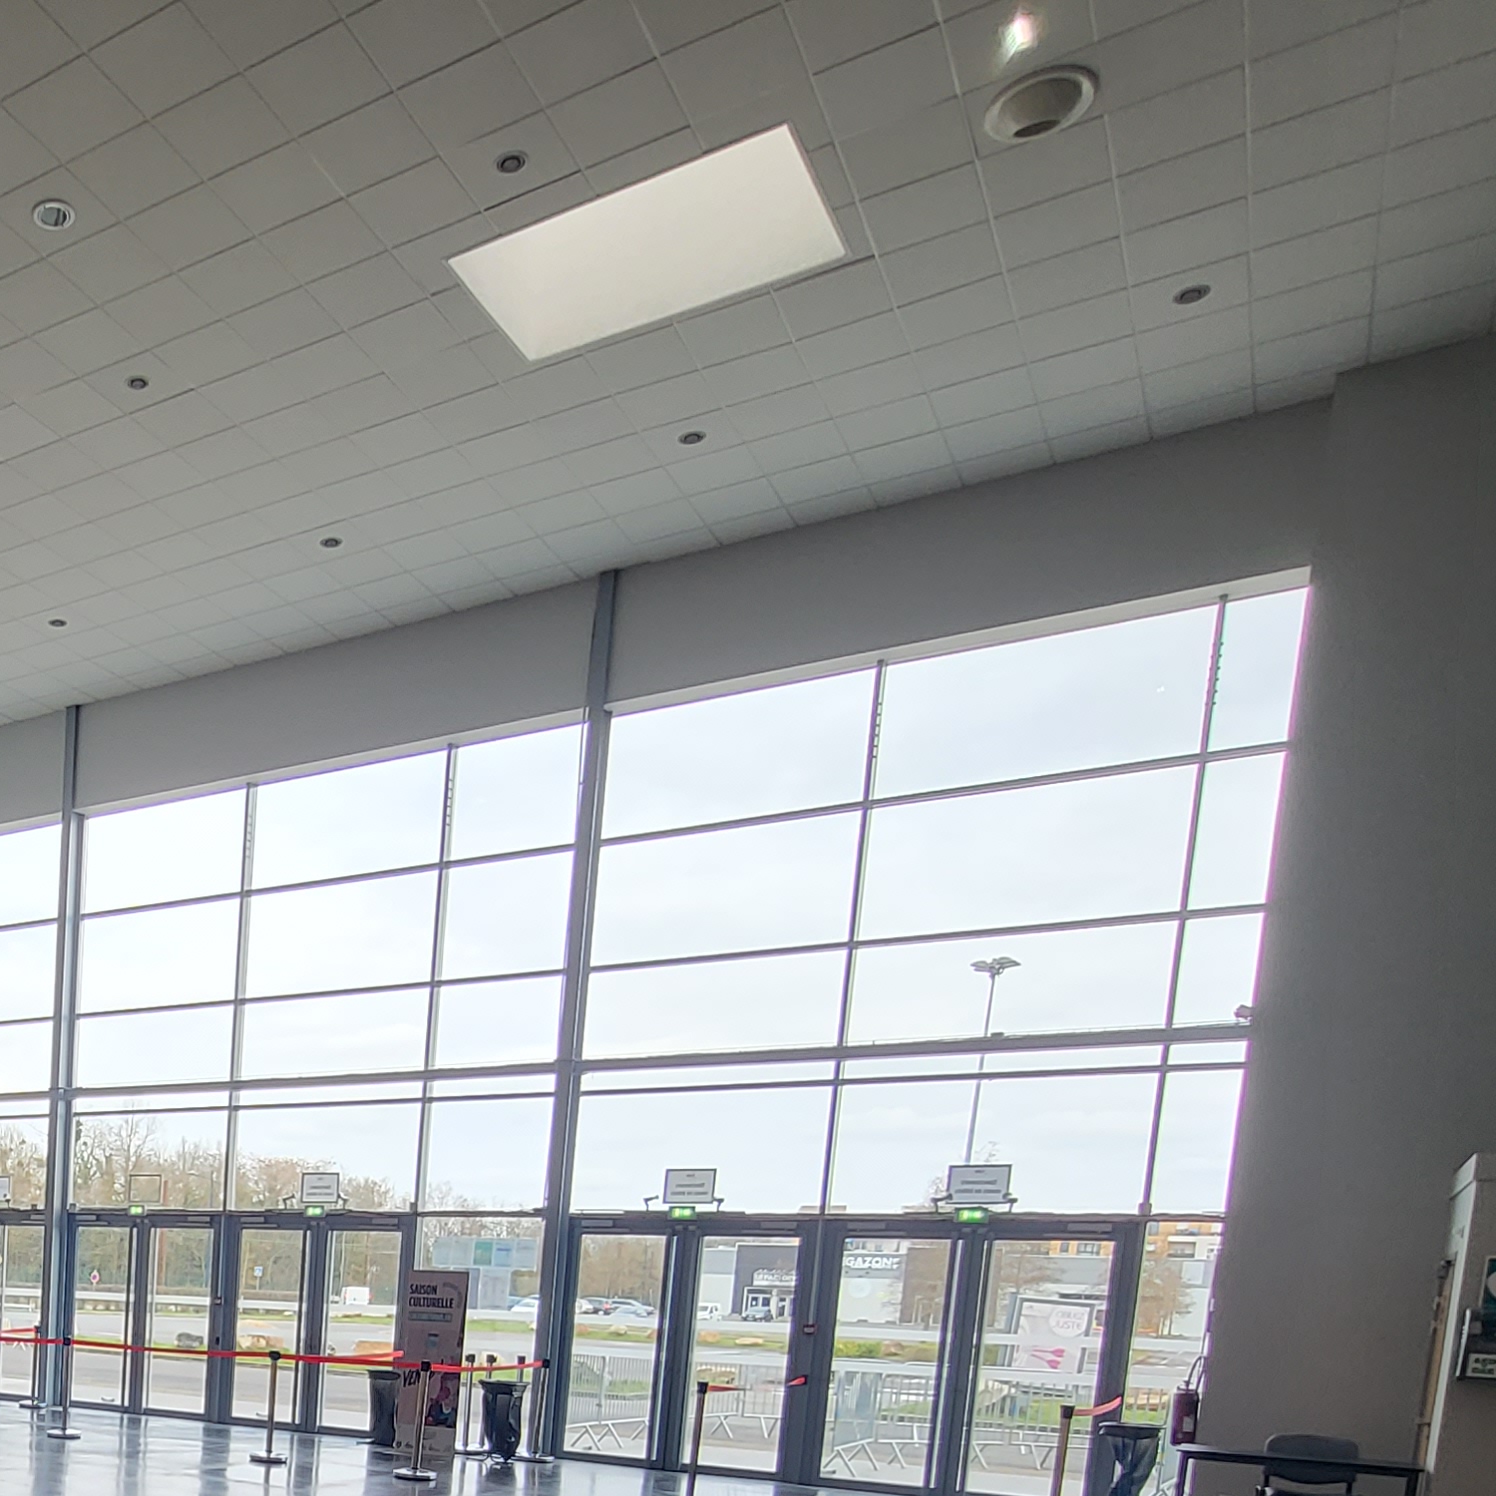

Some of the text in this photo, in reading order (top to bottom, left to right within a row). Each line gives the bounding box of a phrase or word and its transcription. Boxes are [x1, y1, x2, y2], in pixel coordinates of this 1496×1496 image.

[843, 1256, 901, 1269] GAZONE
[409, 1283, 438, 1296] SAISON
[408, 1296, 454, 1309] CULTURELLE
